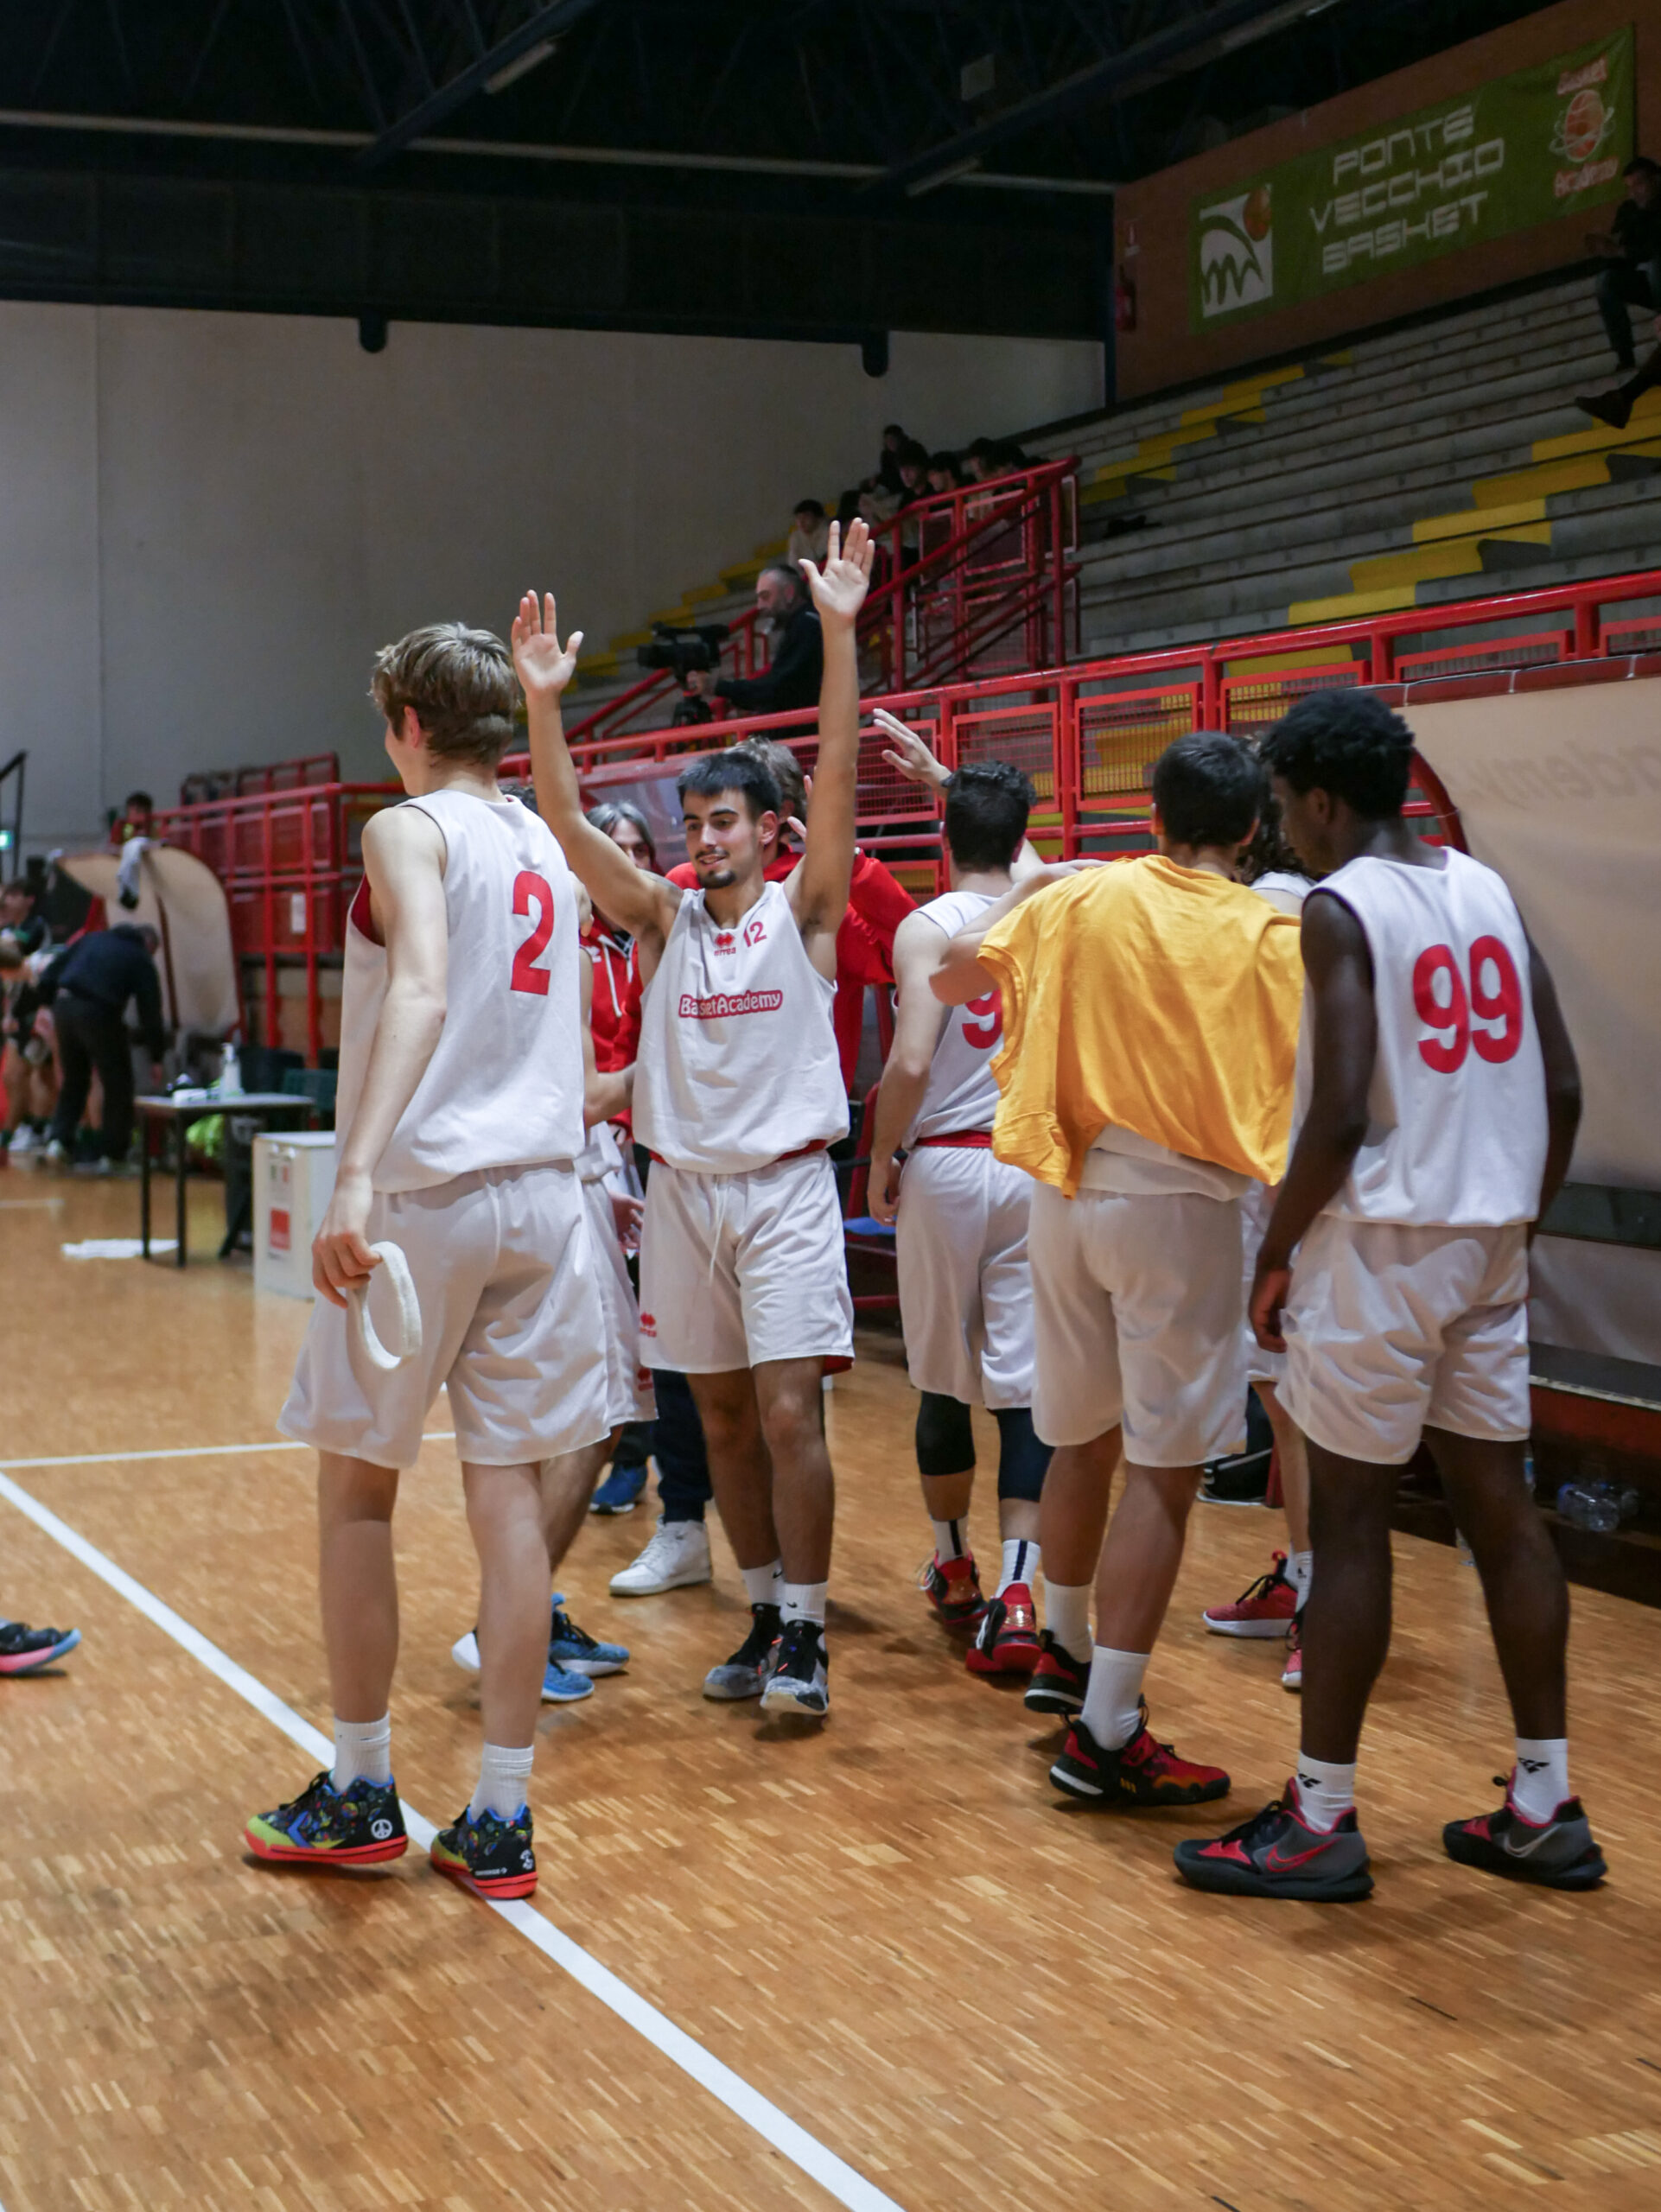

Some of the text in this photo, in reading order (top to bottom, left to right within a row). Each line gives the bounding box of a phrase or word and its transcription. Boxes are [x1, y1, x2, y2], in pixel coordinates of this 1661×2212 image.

[1309, 137, 1505, 233] VECCHIO
[1322, 191, 1488, 274] BASKET
[510, 870, 554, 995] 2
[743, 921, 767, 947] 12
[679, 991, 782, 1017] BasetAcademy
[1413, 935, 1523, 1073] 99
